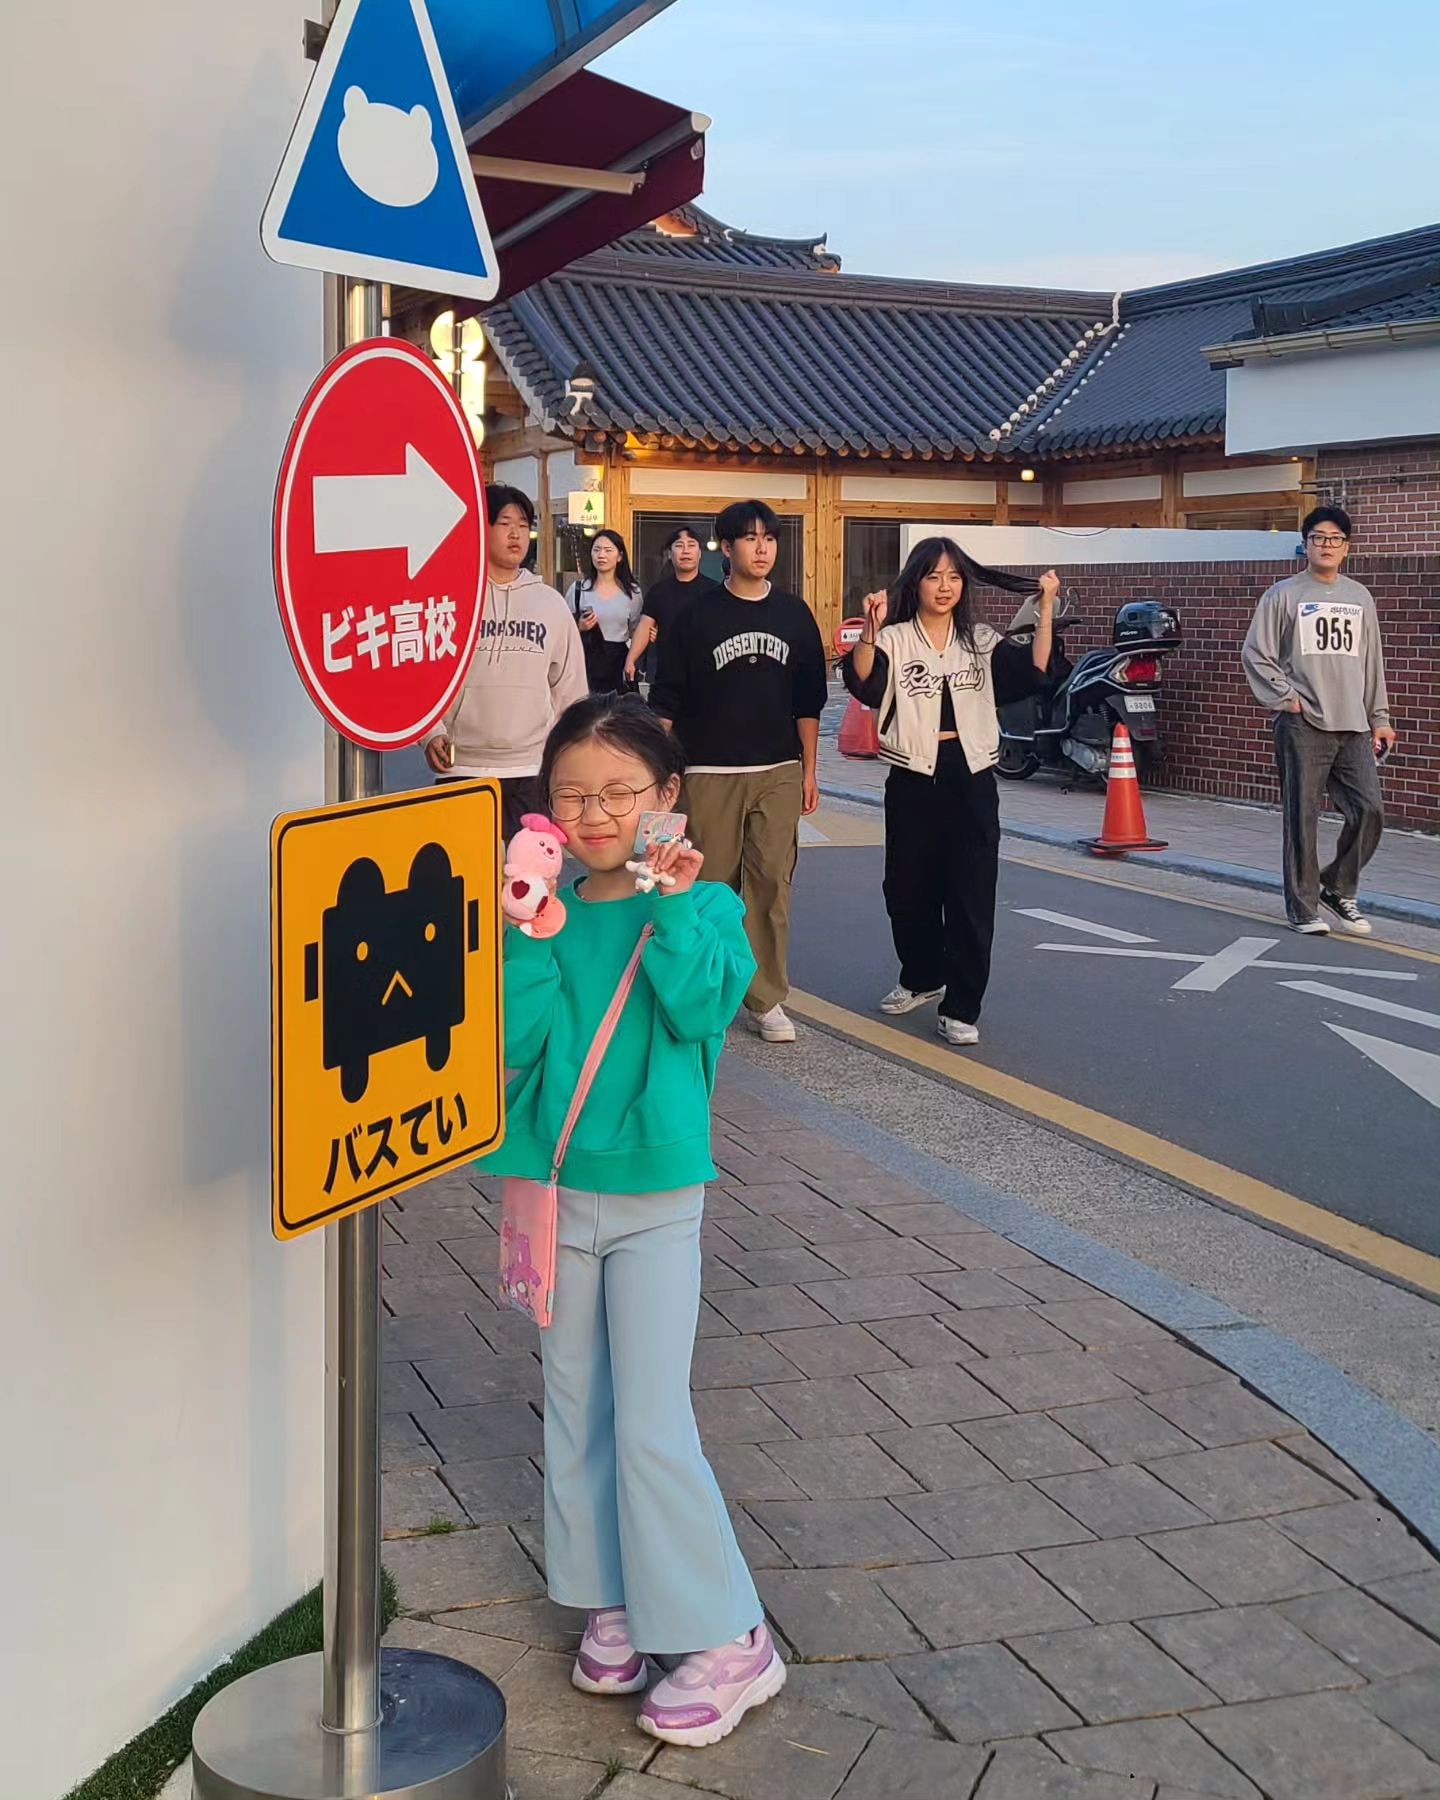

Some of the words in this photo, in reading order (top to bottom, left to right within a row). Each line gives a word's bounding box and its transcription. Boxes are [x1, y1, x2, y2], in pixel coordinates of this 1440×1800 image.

[322, 595, 457, 673] ビキ高校
[479, 619, 547, 651] HRASHER
[712, 631, 790, 671] DISSENTERY
[1315, 616, 1353, 652] 955
[323, 1092, 467, 1195] バスてい
